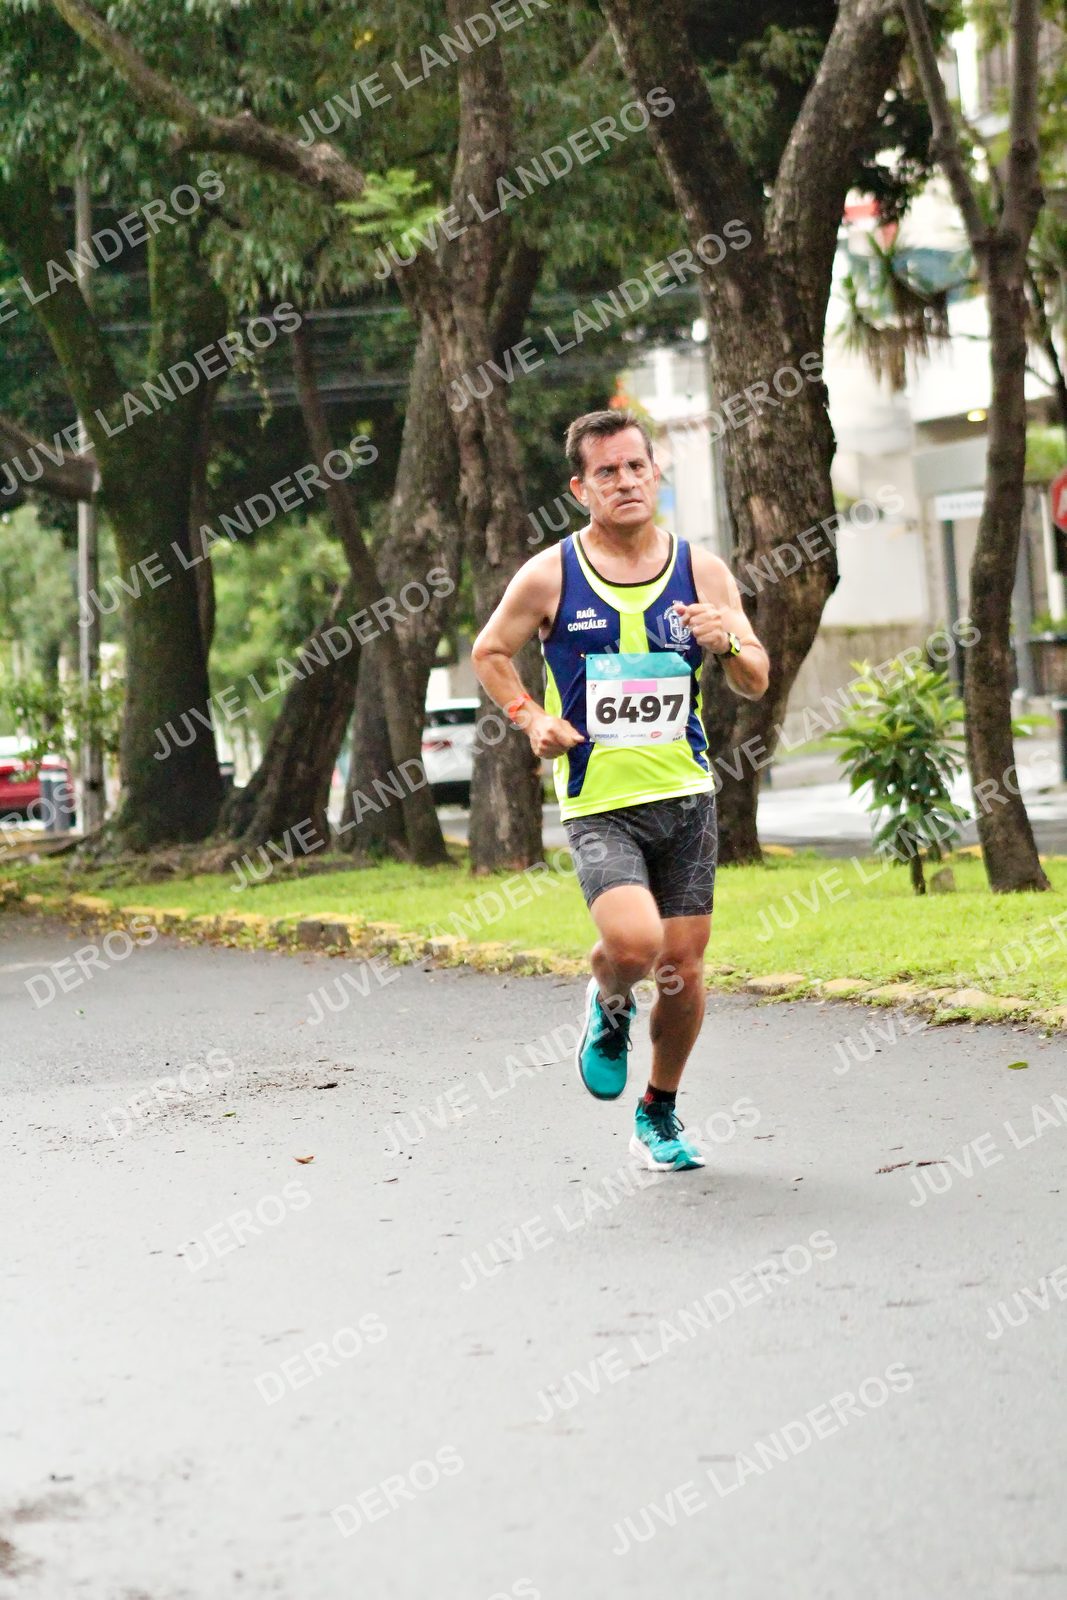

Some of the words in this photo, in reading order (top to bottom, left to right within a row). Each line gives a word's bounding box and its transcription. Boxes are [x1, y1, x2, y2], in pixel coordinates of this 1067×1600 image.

[576, 607, 597, 619] RAÚL
[567, 618, 607, 632] GONZÁLEZ
[595, 694, 684, 725] 6497
